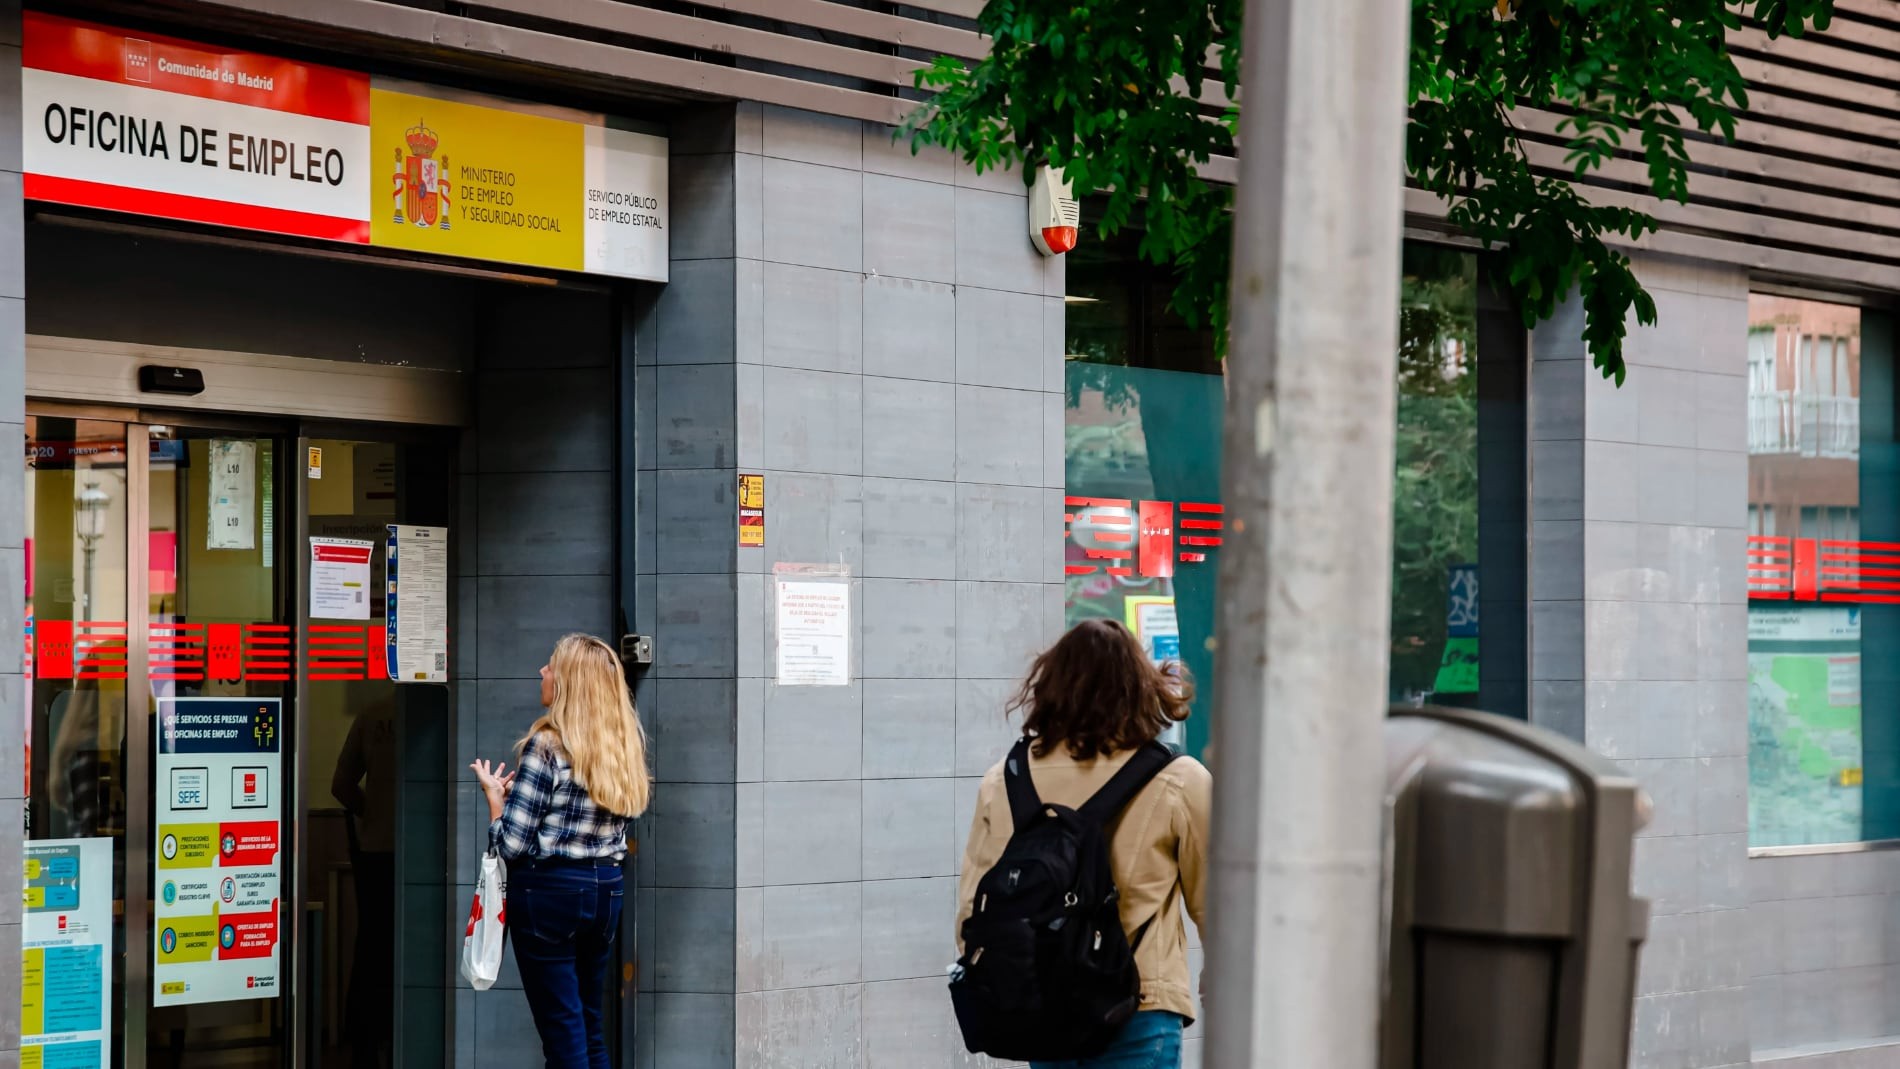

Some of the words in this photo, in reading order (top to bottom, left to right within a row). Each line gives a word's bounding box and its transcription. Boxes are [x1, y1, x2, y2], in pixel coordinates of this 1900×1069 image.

[158, 57, 219, 81] Comunidad
[221, 69, 235, 84] de
[237, 71, 273, 91] Madrid
[44, 102, 169, 160] OFICINA
[180, 124, 218, 167] DE
[228, 132, 344, 186] EMPLEO
[461, 165, 516, 187] MINISTERIO
[461, 186, 474, 200] DE
[477, 188, 514, 206] EMPLEO
[588, 189, 623, 204] SERVICIO
[624, 192, 657, 210] PÚBLICO
[461, 206, 467, 220] Y
[470, 207, 525, 228] SEGURIDAD
[528, 215, 561, 233] SOCIAL
[588, 208, 599, 221] DE
[601, 209, 631, 225] EMPLEO
[632, 213, 663, 230] ESTATAL
[68, 447, 98, 456] PUESTO
[180, 714, 212, 724] SERVICIOS
[213, 714, 221, 724] SE
[221, 714, 248, 724] PRESTAN
[174, 729, 202, 739] OFICINAS
[203, 729, 211, 739] DE
[212, 729, 239, 739] EMPLEO?
[178, 790, 201, 804] SEPE
